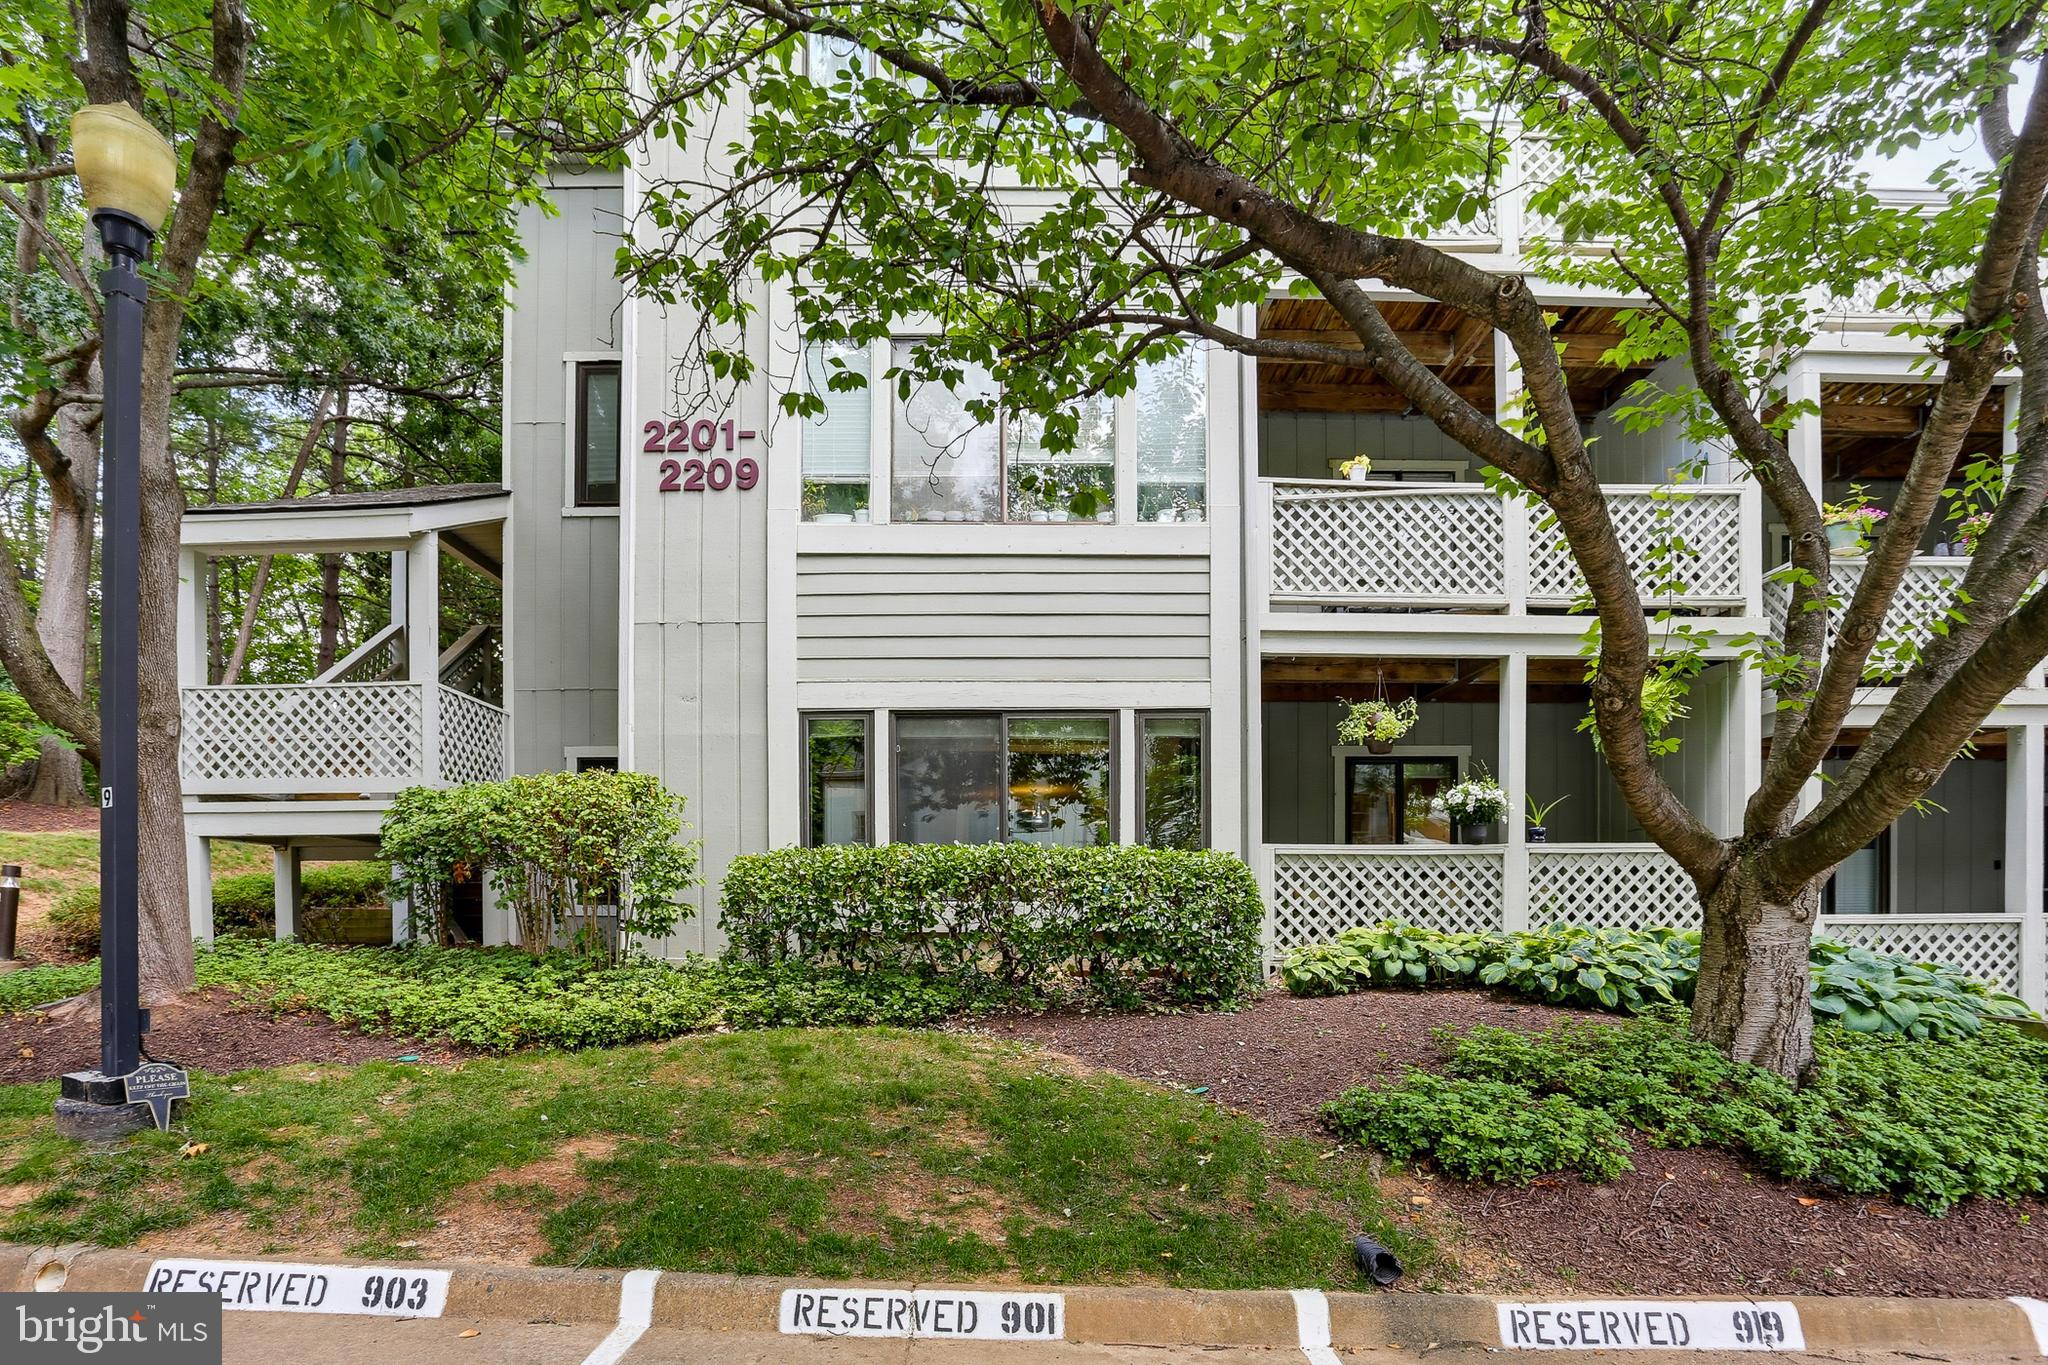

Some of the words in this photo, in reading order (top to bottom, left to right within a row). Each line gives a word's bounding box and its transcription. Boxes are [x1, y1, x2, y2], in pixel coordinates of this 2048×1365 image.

[643, 419, 756, 453] 2201-
[659, 458, 760, 492] 2209
[104, 789, 110, 806] 9
[135, 1073, 178, 1083] PLEASE
[149, 1268, 329, 1307] RESERVED
[361, 1275, 429, 1310] 903
[793, 1293, 979, 1334] RESERVED
[1001, 1301, 1055, 1335] 901
[1509, 1309, 1691, 1346] RESERVED
[1732, 1310, 1785, 1344] 919
